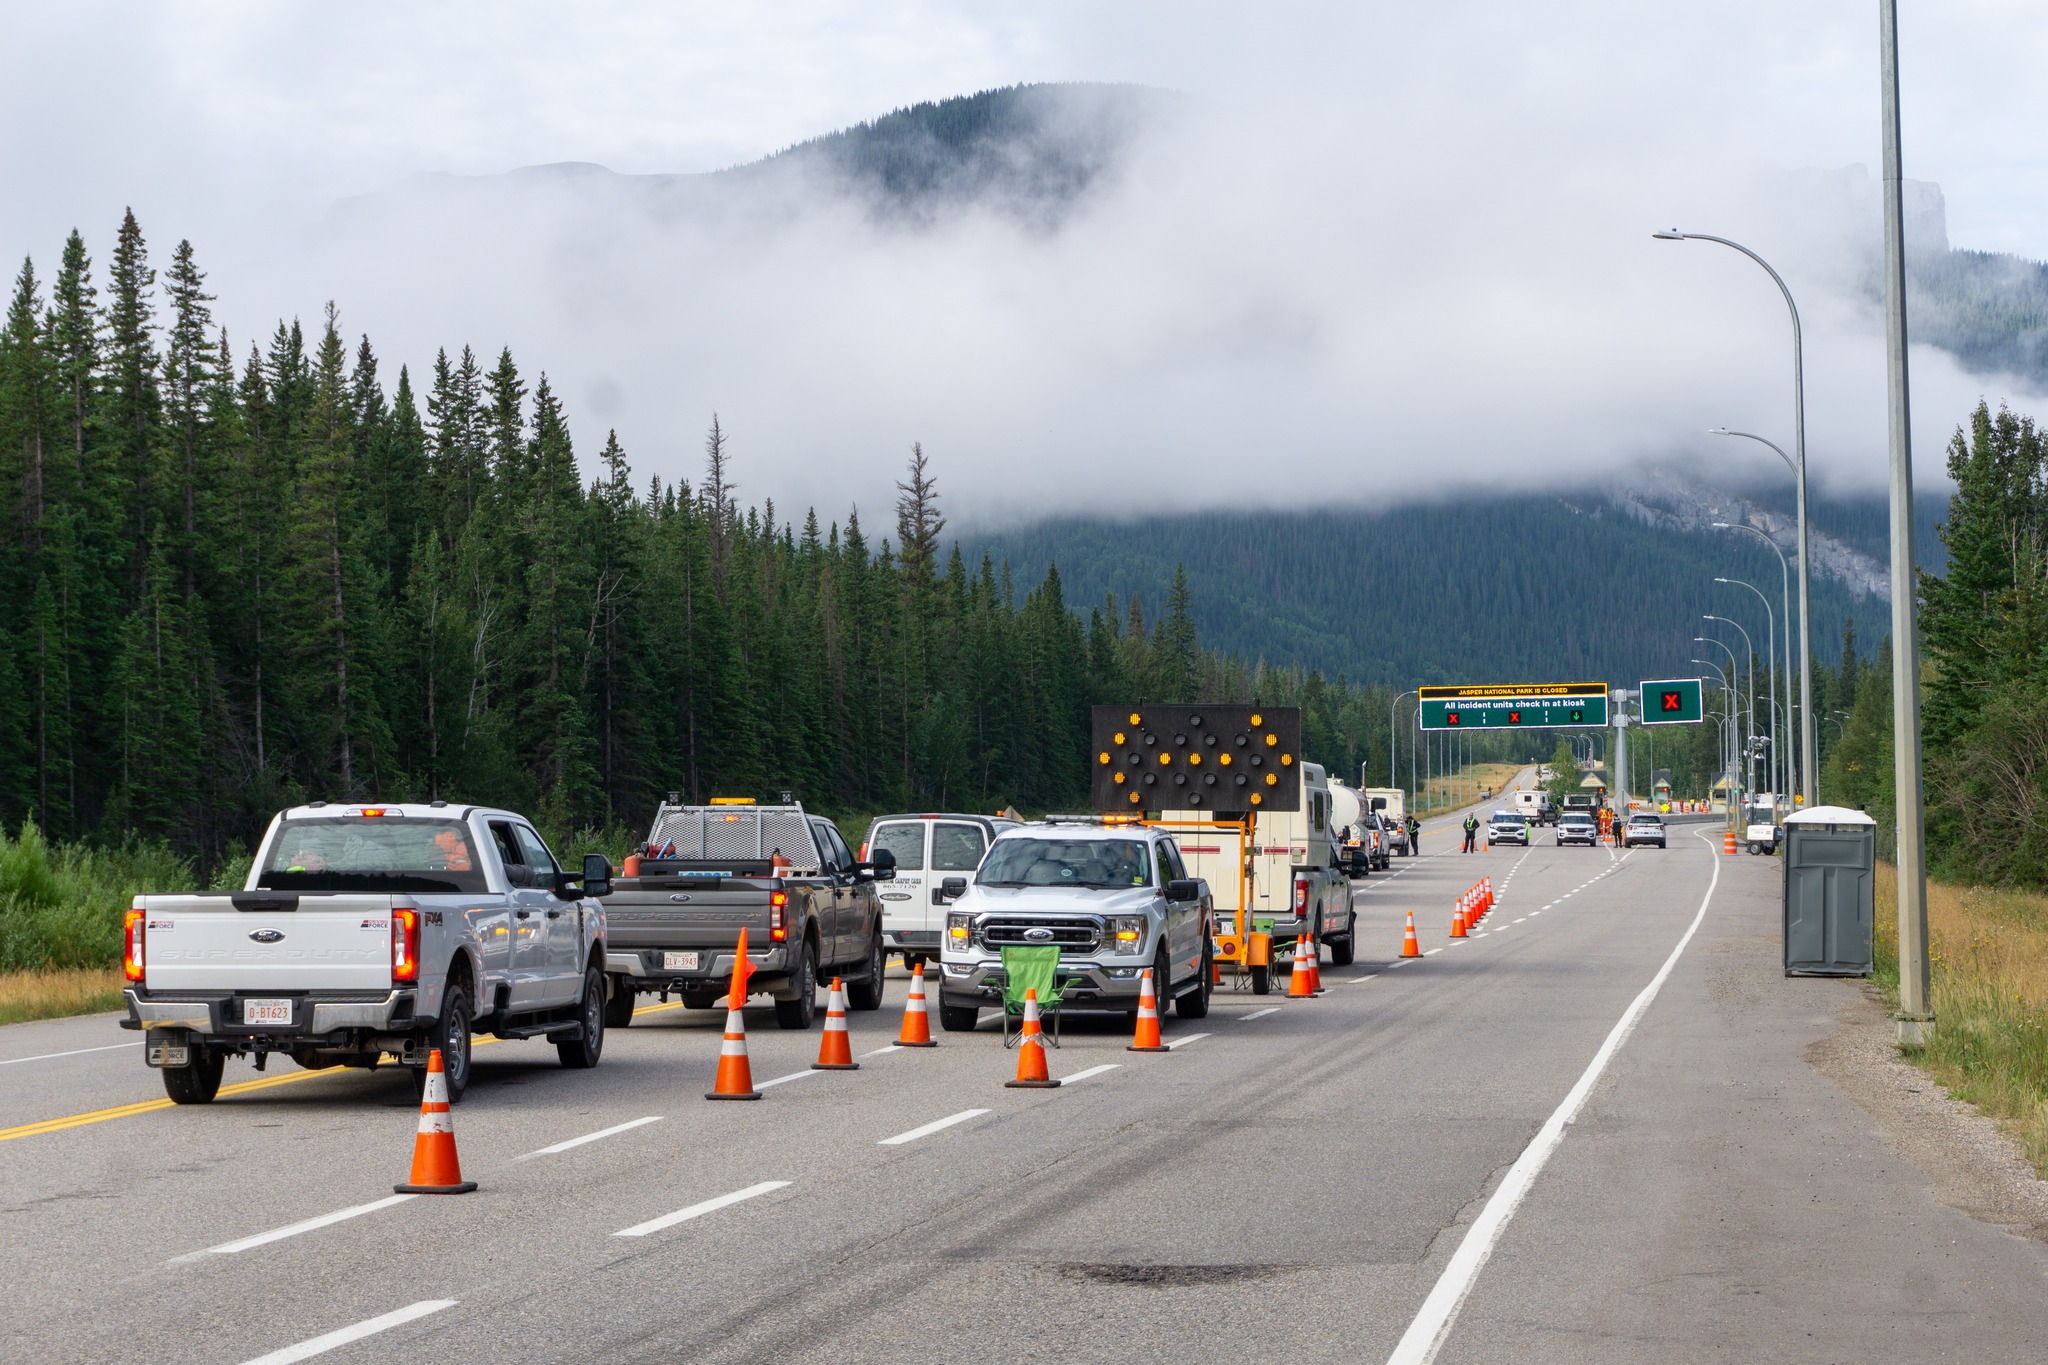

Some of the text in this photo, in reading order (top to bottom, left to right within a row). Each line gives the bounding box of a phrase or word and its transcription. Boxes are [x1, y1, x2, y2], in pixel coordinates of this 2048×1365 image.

[1458, 688, 1482, 696] JASPER
[1484, 687, 1515, 695] NATIONAL
[1444, 701, 1456, 709] All
[1457, 701, 1491, 709] incident
[1493, 700, 1513, 708] units
[1515, 700, 1540, 708] check
[1563, 699, 1585, 707] kiosk
[424, 911, 443, 927] FX4
[607, 912, 756, 921] SUPER DUTY
[159, 949, 377, 960] SUPER DUTY
